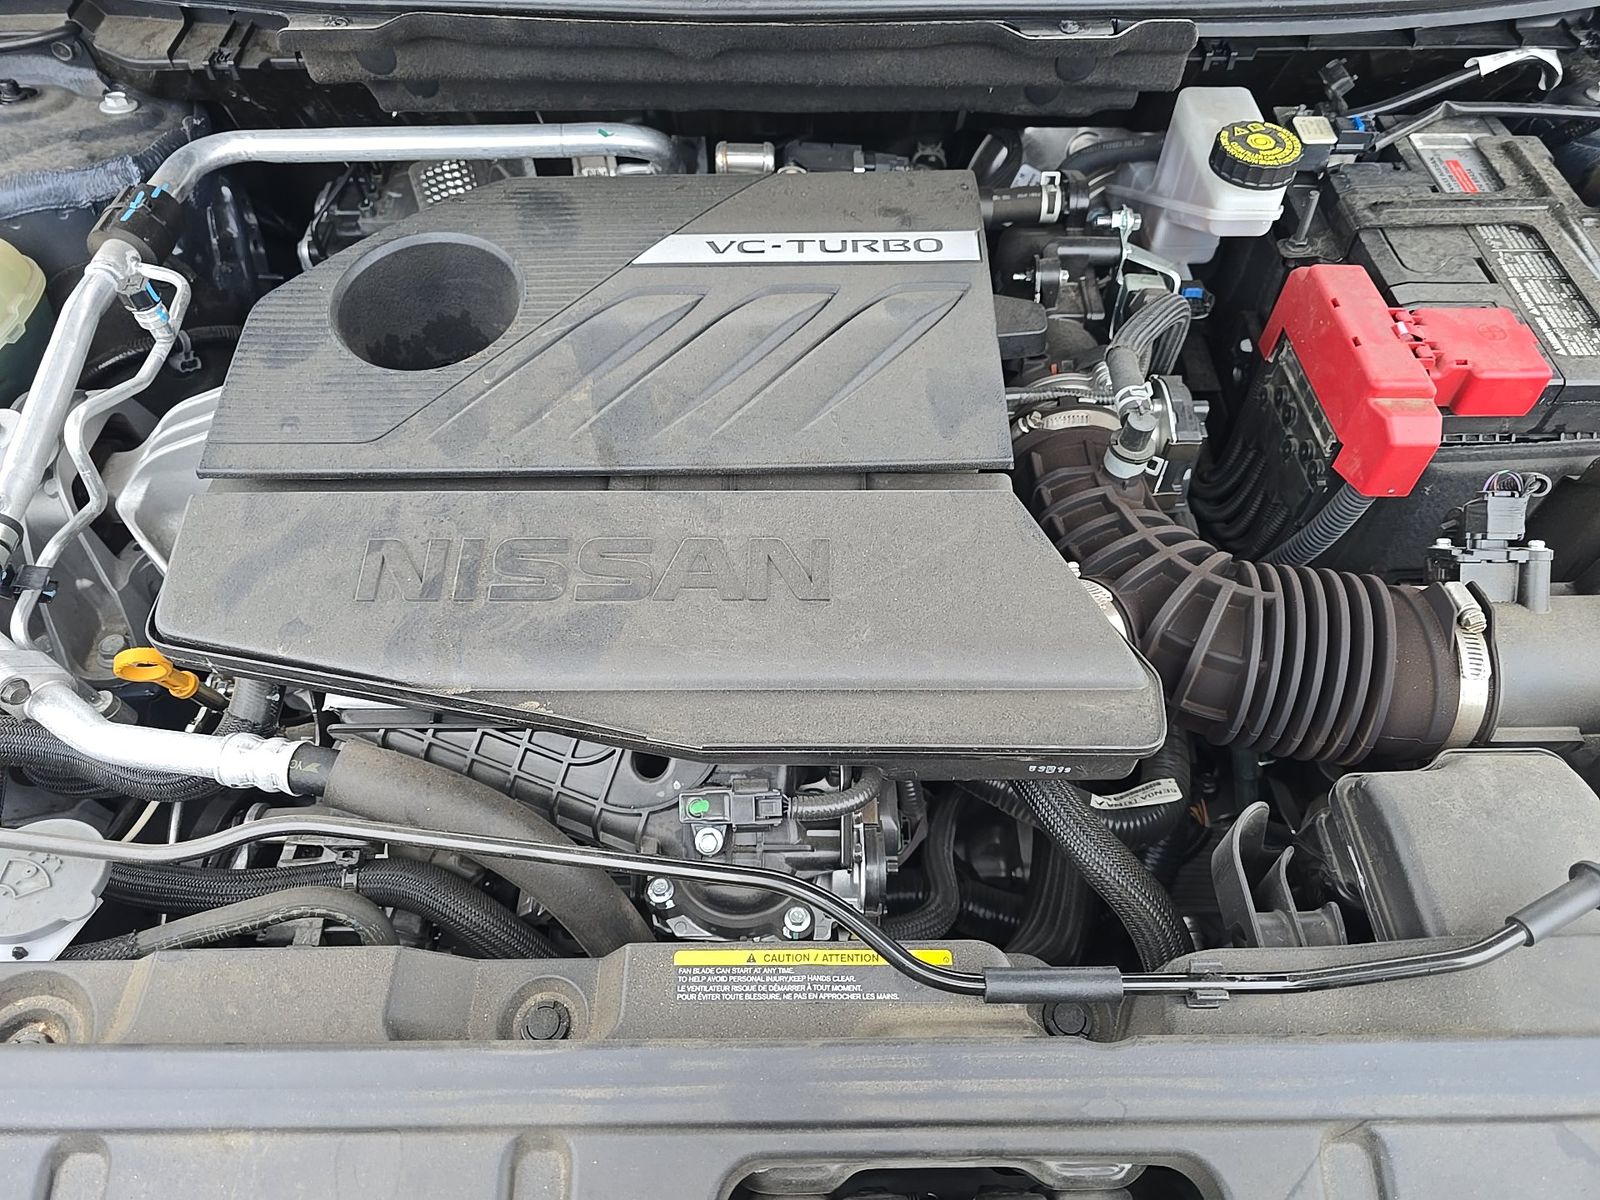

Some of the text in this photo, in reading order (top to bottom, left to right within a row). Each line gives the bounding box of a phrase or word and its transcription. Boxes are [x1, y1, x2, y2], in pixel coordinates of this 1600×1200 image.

[705, 237, 944, 254] VC-TURBO
[354, 536, 832, 601] NISSAN
[763, 953, 879, 962] CAUTION / ATTENTION
[677, 984, 686, 992] LE
[686, 984, 730, 992] VENTILATEUR
[731, 984, 757, 992] RISQUE
[758, 984, 768, 992] DE
[768, 983, 805, 992] DÉMARRER
[806, 983, 812, 992] À
[813, 984, 831, 992] TOUT
[698, 991, 721, 1000] ÉVITER
